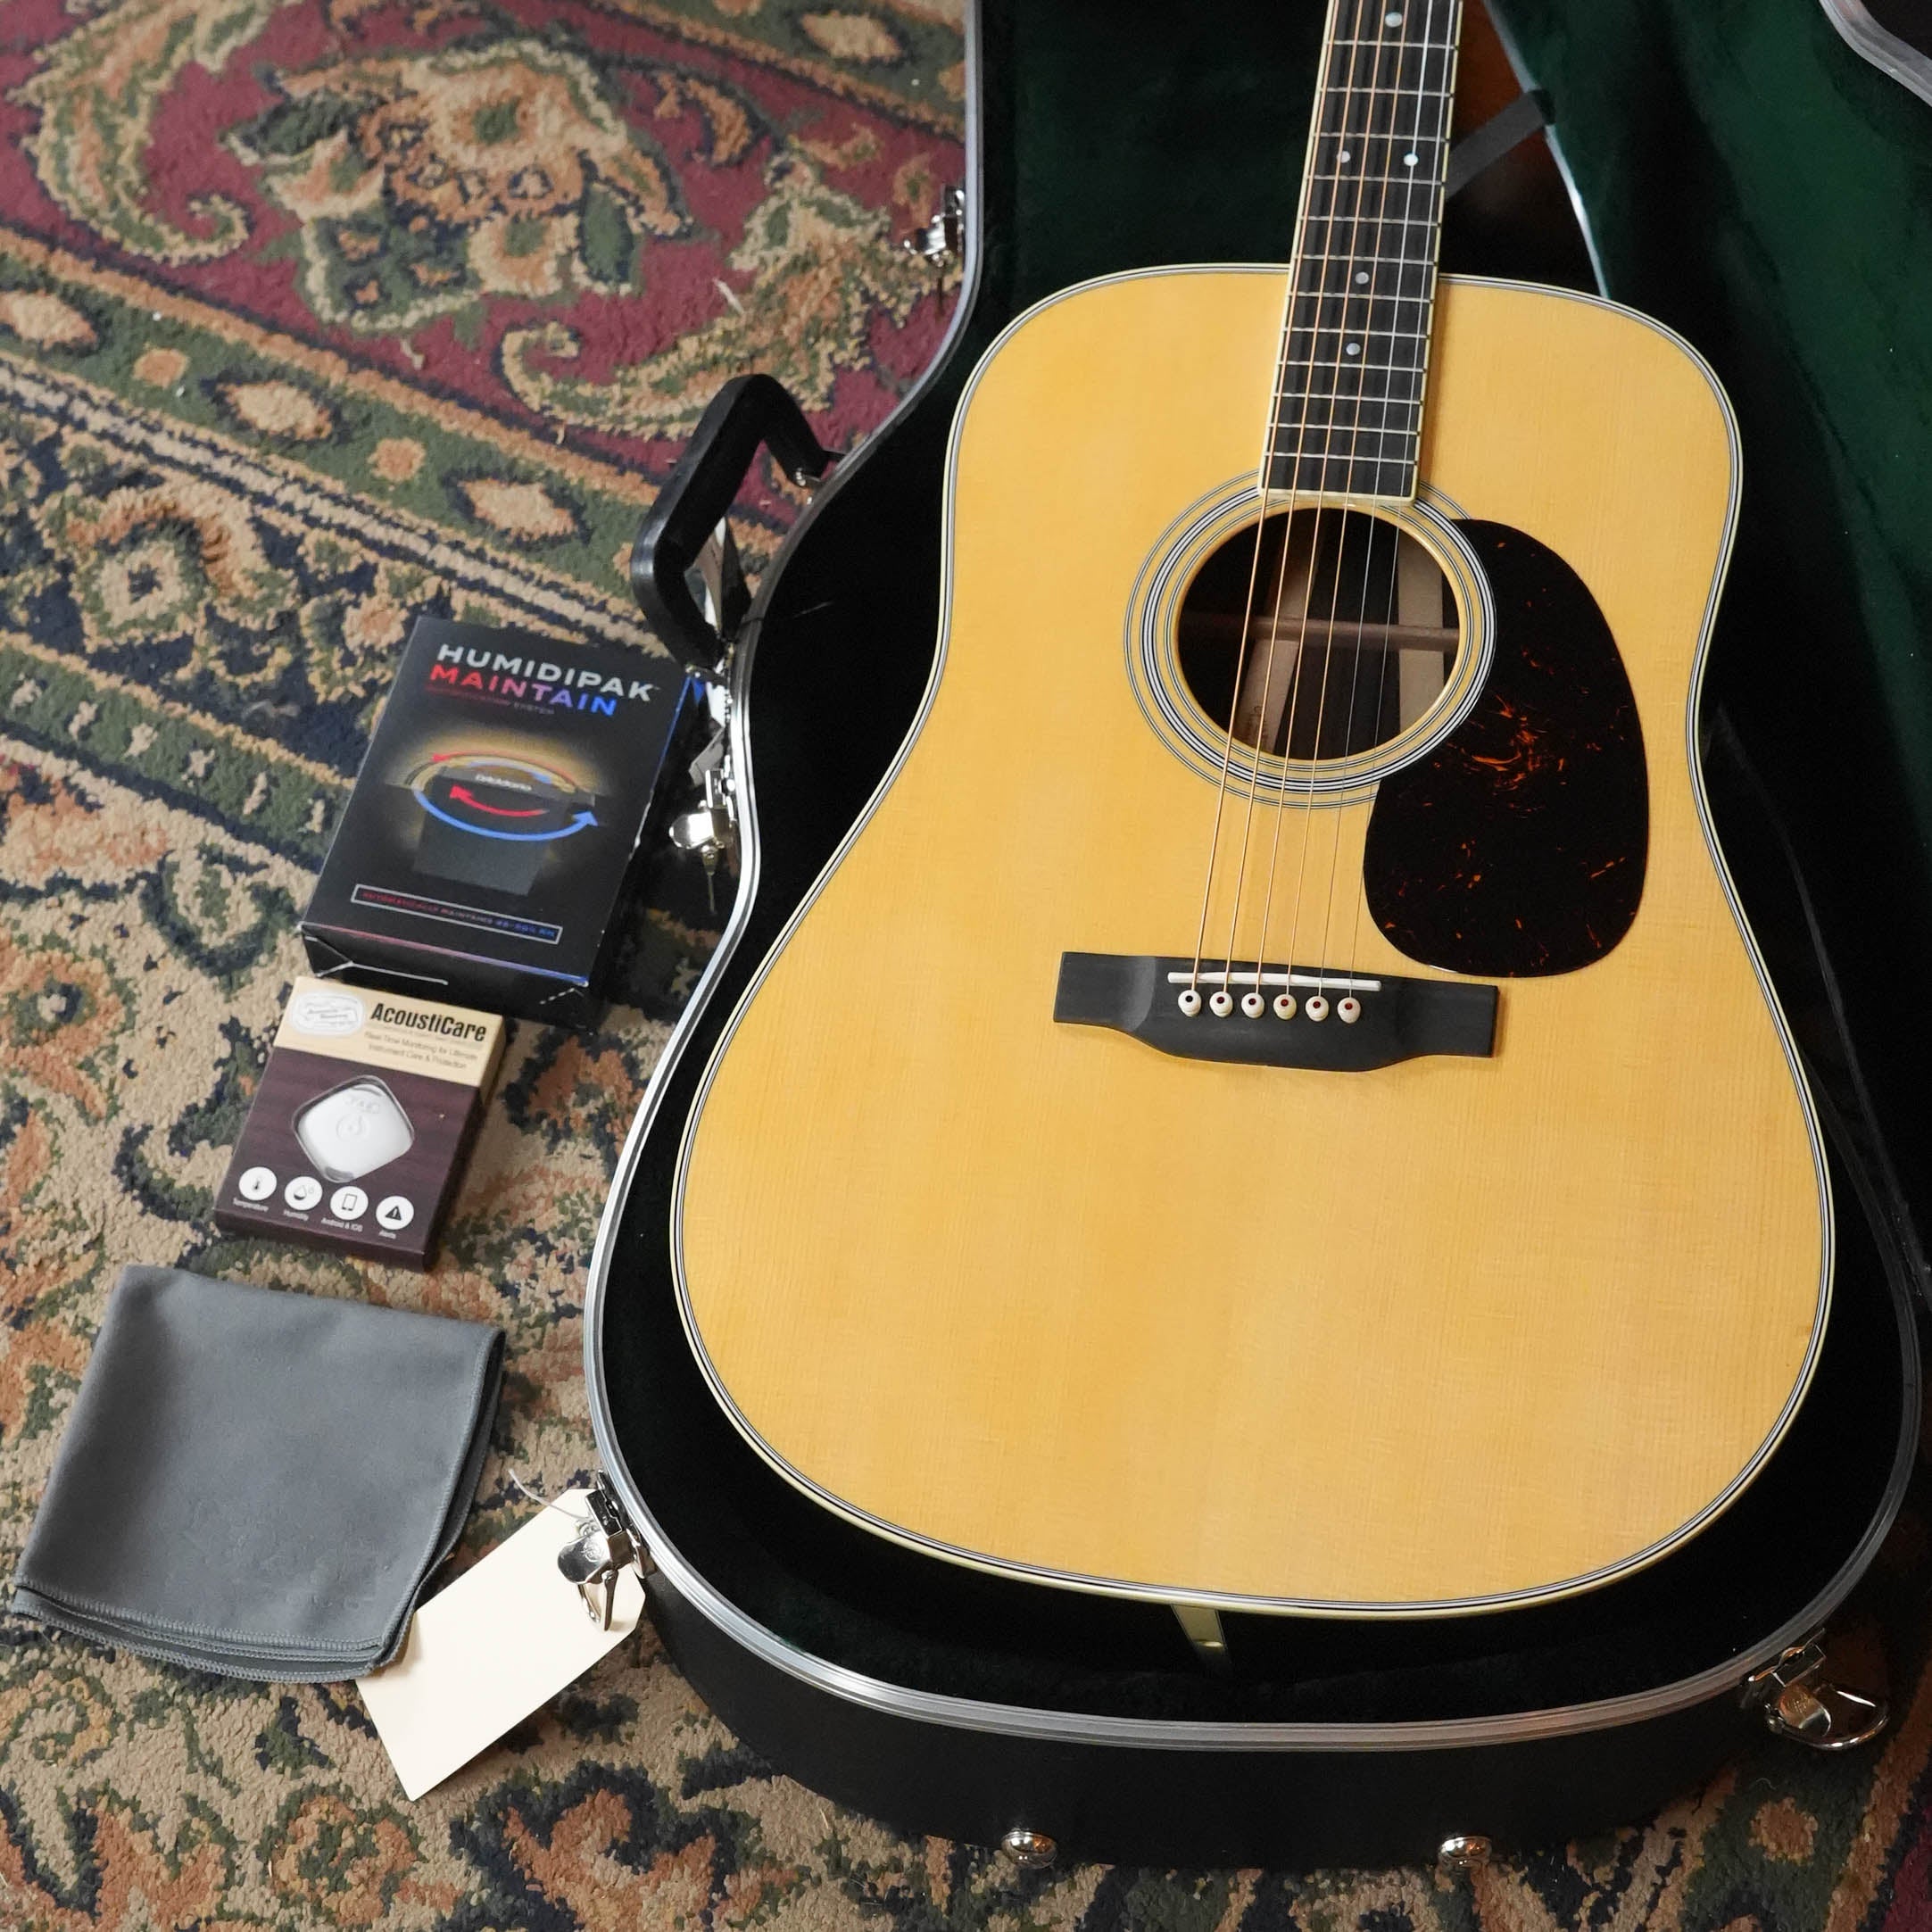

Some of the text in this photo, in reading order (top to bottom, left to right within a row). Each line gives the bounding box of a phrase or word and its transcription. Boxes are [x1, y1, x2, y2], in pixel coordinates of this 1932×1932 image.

[430, 665, 618, 717] MAINTAIN
[437, 644, 653, 701] HUMIDIPAK
[370, 1003, 487, 1042] AcoustiCare
